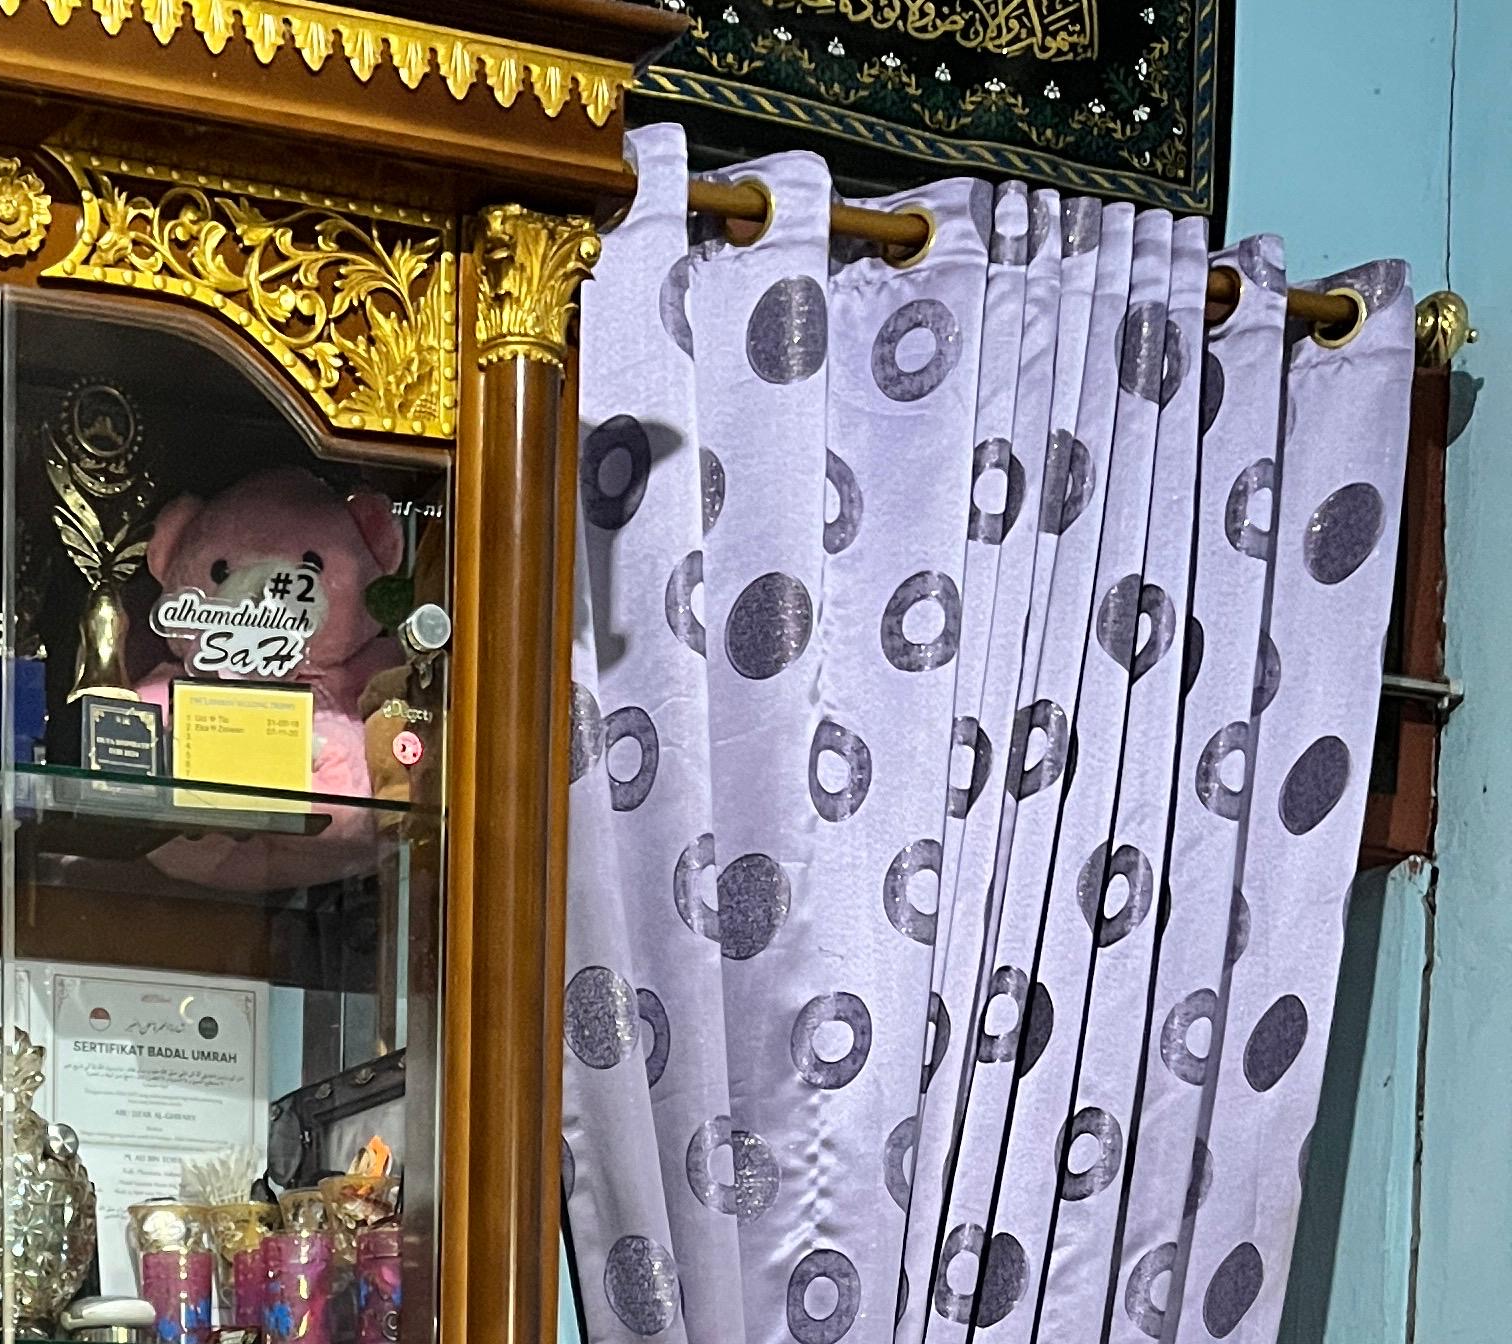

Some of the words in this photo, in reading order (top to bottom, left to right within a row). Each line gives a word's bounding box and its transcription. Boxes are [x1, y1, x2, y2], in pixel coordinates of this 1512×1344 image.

[268, 572, 316, 603] #2
[164, 598, 311, 632] alhamdulillah
[73, 1040, 144, 1057] SERTIFIKAT
[147, 1046, 189, 1060] BADAL
[191, 1051, 237, 1064] UMRAH
